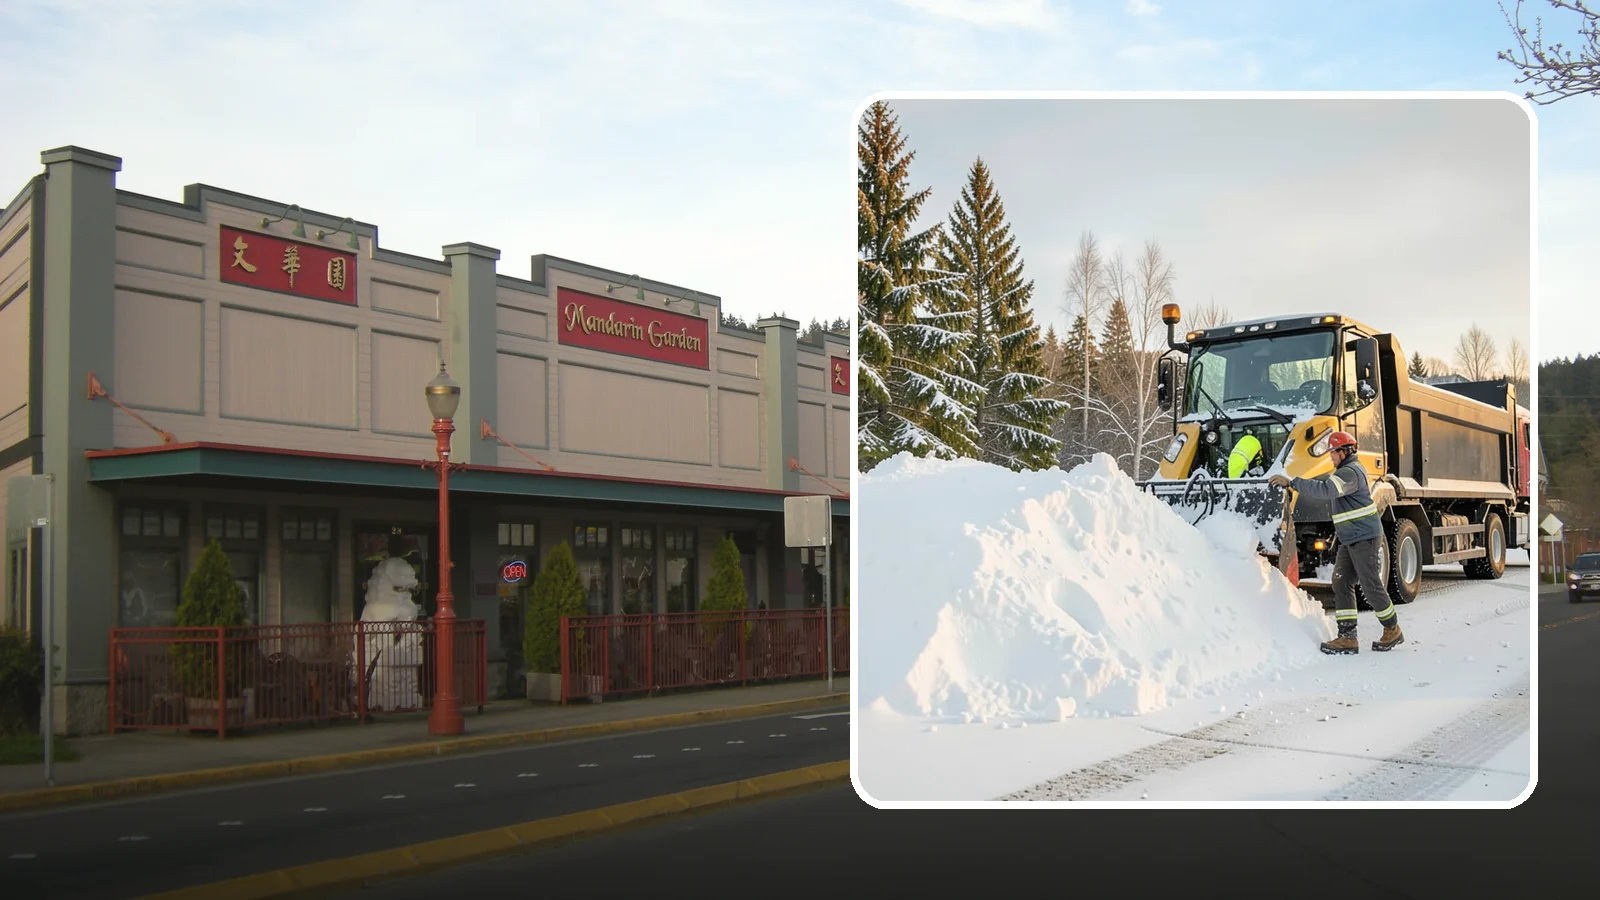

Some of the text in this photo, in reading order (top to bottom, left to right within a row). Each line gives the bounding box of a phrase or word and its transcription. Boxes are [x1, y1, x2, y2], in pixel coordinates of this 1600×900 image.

[230, 235, 346, 291] 文華園
[564, 302, 701, 353] Mandarin Garden
[503, 565, 527, 578] OPEN
